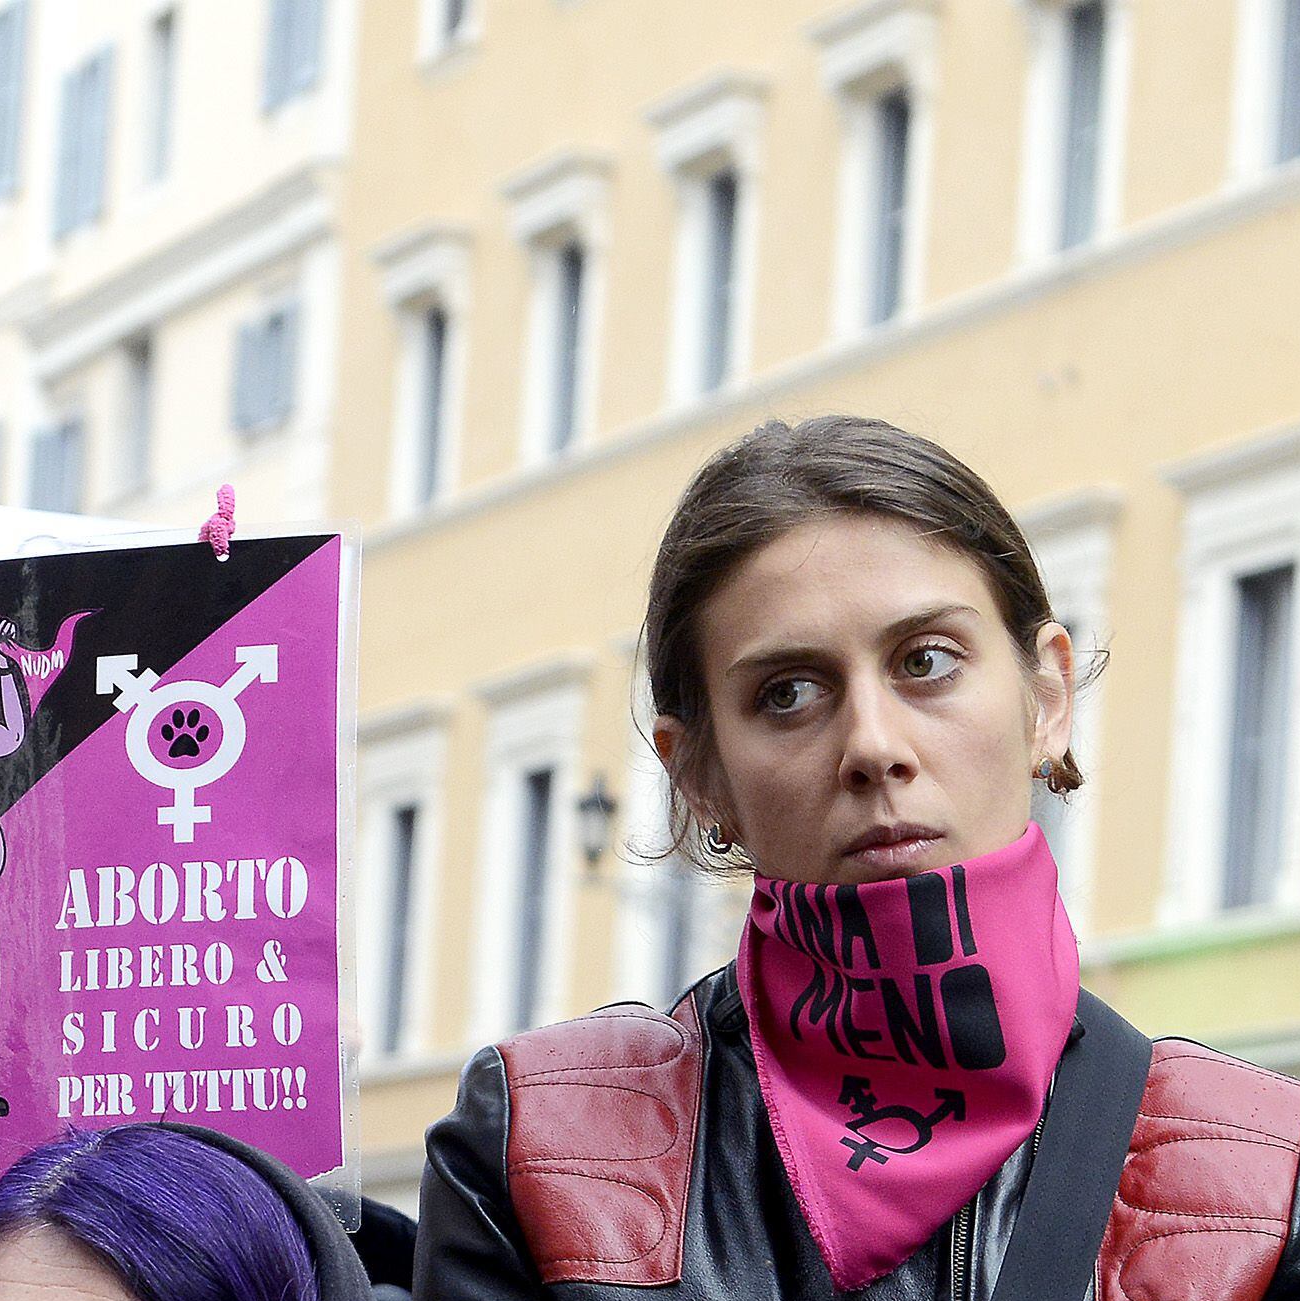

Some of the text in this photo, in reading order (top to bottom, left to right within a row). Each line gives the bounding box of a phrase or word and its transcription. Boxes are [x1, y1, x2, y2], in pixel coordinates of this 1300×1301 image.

[20, 649, 65, 679] NUDM
[55, 856, 309, 930] ABORTO
[905, 863, 978, 967] DI
[58, 939, 289, 992] LIBERO &
[61, 1002, 303, 1055] SICURO
[790, 959, 1008, 1071] MENO
[56, 1065, 308, 1118] PER TUTTU!!
